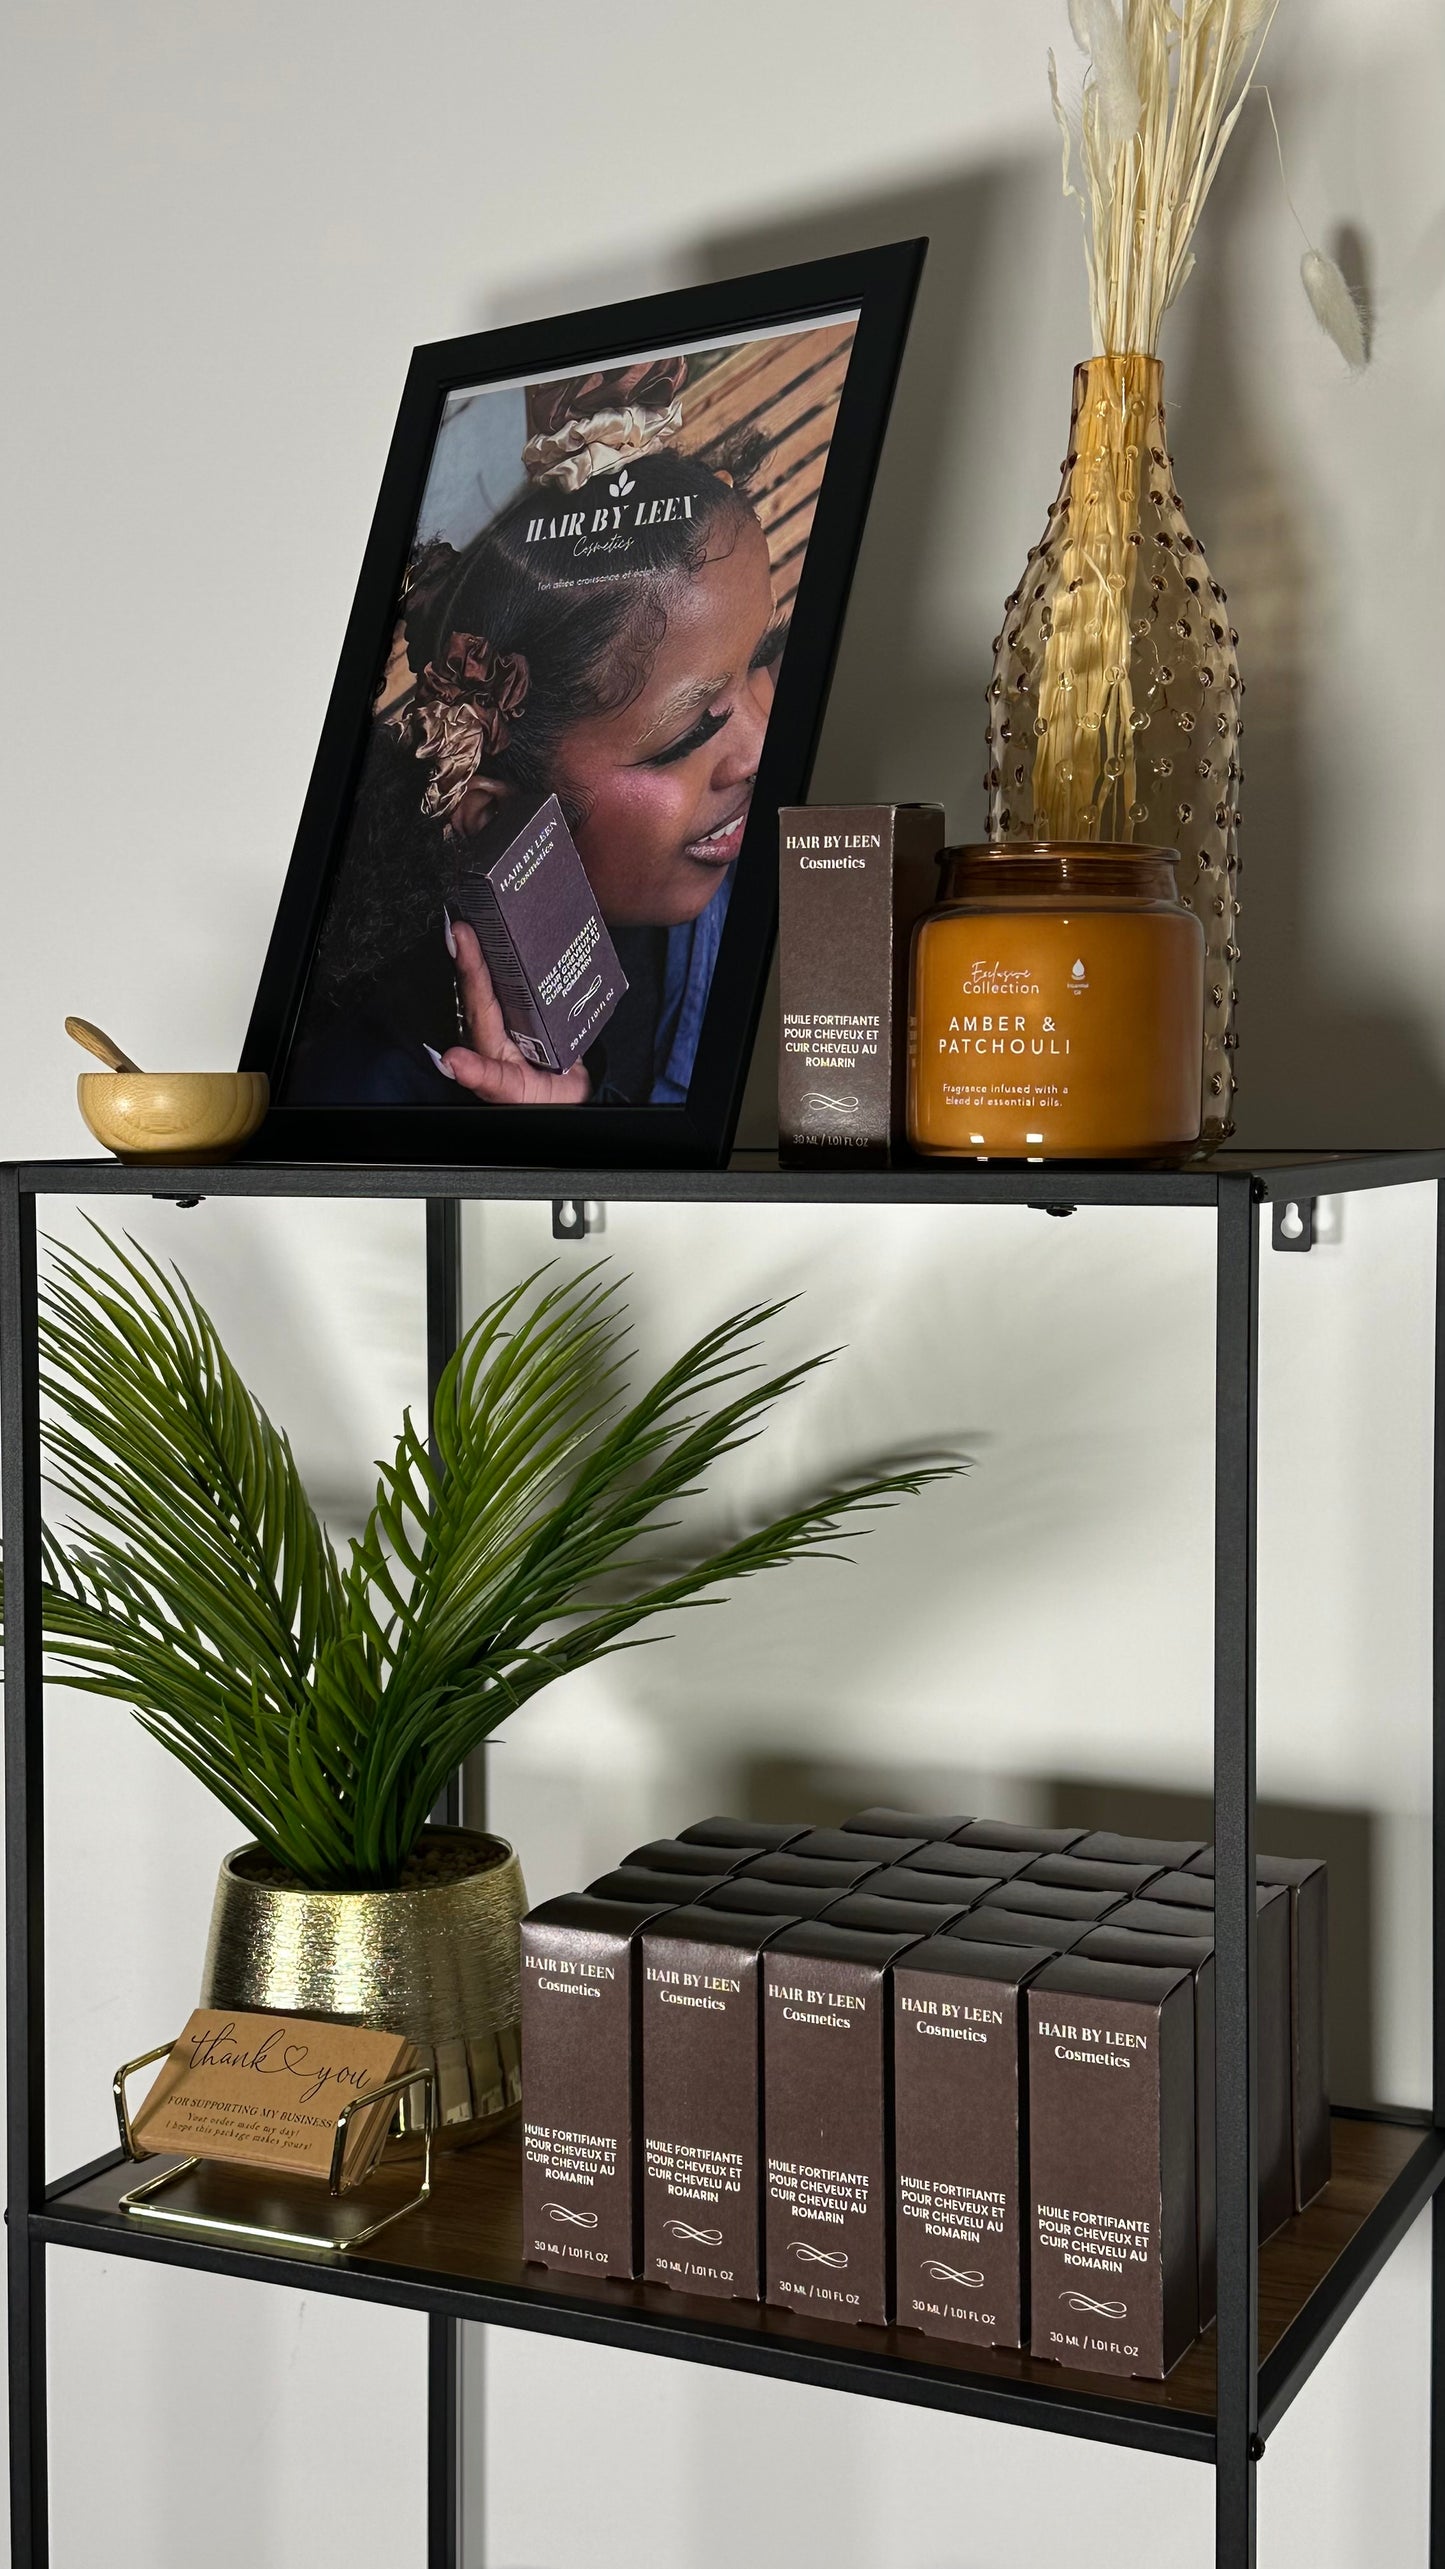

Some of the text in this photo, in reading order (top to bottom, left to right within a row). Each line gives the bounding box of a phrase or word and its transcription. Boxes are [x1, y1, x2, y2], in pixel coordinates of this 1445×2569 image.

[525, 495, 698, 542] HAIR BY LEEN
[573, 534, 635, 557] Cosmetics
[787, 835, 880, 849] HAIR BY LEEN
[500, 862, 523, 892] HAIR
[535, 818, 558, 848] LEEN
[514, 841, 554, 891] Cosmetics
[800, 855, 866, 869] Cosmetics
[963, 982, 1039, 994] Collection
[784, 1014, 879, 1026] HUILE FORTIFIANTE
[949, 1016, 1055, 1031] AMBER &
[784, 1029, 879, 1040] POUR CHEVEUX ET
[939, 1039, 1070, 1054] PATCHOULI
[785, 1043, 877, 1054] CUIR CHEVELU AU
[806, 1057, 855, 1068] ROMARIN
[943, 1084, 987, 1093] Fragrance
[991, 1084, 1030, 1094] infused
[1035, 1085, 1057, 1094] with
[946, 1097, 1062, 1107] blend of essential oils.
[793, 1135, 804, 1144] 30
[806, 1135, 818, 1144] ML
[844, 1137, 853, 1146] FL
[856, 1138, 868, 1147] OZ
[525, 1955, 615, 1980] HAIR BY LEEN
[538, 1977, 600, 1998] Cosmetics
[647, 1968, 740, 1992] HAIR BY LEEN
[660, 1990, 725, 2011] Cosmetics
[769, 1984, 865, 2011] HAIR BY LEEN
[783, 2007, 850, 2029] Cosmetics
[902, 1997, 1003, 2025] HAIR BY LEEN
[916, 2020, 987, 2043] Cosmetics
[1038, 2021, 1147, 2050] HAIR BY LEEN
[189, 2022, 371, 2103] thank you
[1054, 2045, 1130, 2068] Cosmetics
[168, 2096, 188, 2106] FOR
[190, 2098, 258, 2115] SUPPORTING
[261, 2108, 279, 2118] MY
[524, 2123, 617, 2149] HUILE FORTIFIANTE
[525, 2137, 616, 2162] POUR CHEVEUX ET
[646, 2139, 743, 2165] HUILE FORTIFIANTE
[526, 2151, 615, 2175] CUIR CHEVELU AU
[647, 2152, 742, 2178] POUR CHEVEUX ET
[769, 2159, 869, 2186] HUILE FORTIFIANTE
[546, 2169, 594, 2186] ROMARIN
[648, 2166, 741, 2192] CUIR CHEVELU AU
[769, 2173, 868, 2200] POUR CHEVEUX ET
[901, 2175, 1006, 2204] HUILE FORTIFIANTE
[668, 2184, 719, 2202] ROMARIN
[771, 2187, 867, 2214] CUIR CHEVELU AU
[902, 2190, 1005, 2218] POUR CHEVEUX ET
[792, 2206, 844, 2224] ROMARIN
[903, 2205, 1003, 2232] CUIR CHEVELU AU
[1038, 2205, 1150, 2233] HUILE FORTIFIANTE
[925, 2224, 980, 2243] ROMARIN
[1039, 2219, 1149, 2248] POUR CHEVEUX ET
[535, 2240, 545, 2250] 30
[548, 2243, 559, 2254] ML
[585, 2250, 593, 2260] FL
[596, 2253, 609, 2263] OZ
[1040, 2234, 1147, 2262] CUIR CHEVELU AU
[656, 2258, 668, 2268] 30
[670, 2261, 681, 2272] ML
[708, 2268, 718, 2278] FL
[720, 2271, 733, 2280] OZ
[1064, 2253, 1123, 2273] ROMARIN
[779, 2281, 791, 2292] 30
[794, 2284, 806, 2296] ML
[834, 2291, 843, 2302] FL
[846, 2294, 860, 2305] OZ
[912, 2300, 925, 2311] 30
[927, 2303, 940, 2315] ML
[969, 2311, 979, 2321] FL
[981, 2313, 996, 2325] OZ
[1050, 2332, 1063, 2342] 30
[1066, 2335, 1079, 2346] ML
[1110, 2342, 1121, 2353] FL
[1124, 2346, 1138, 2357] OZ
